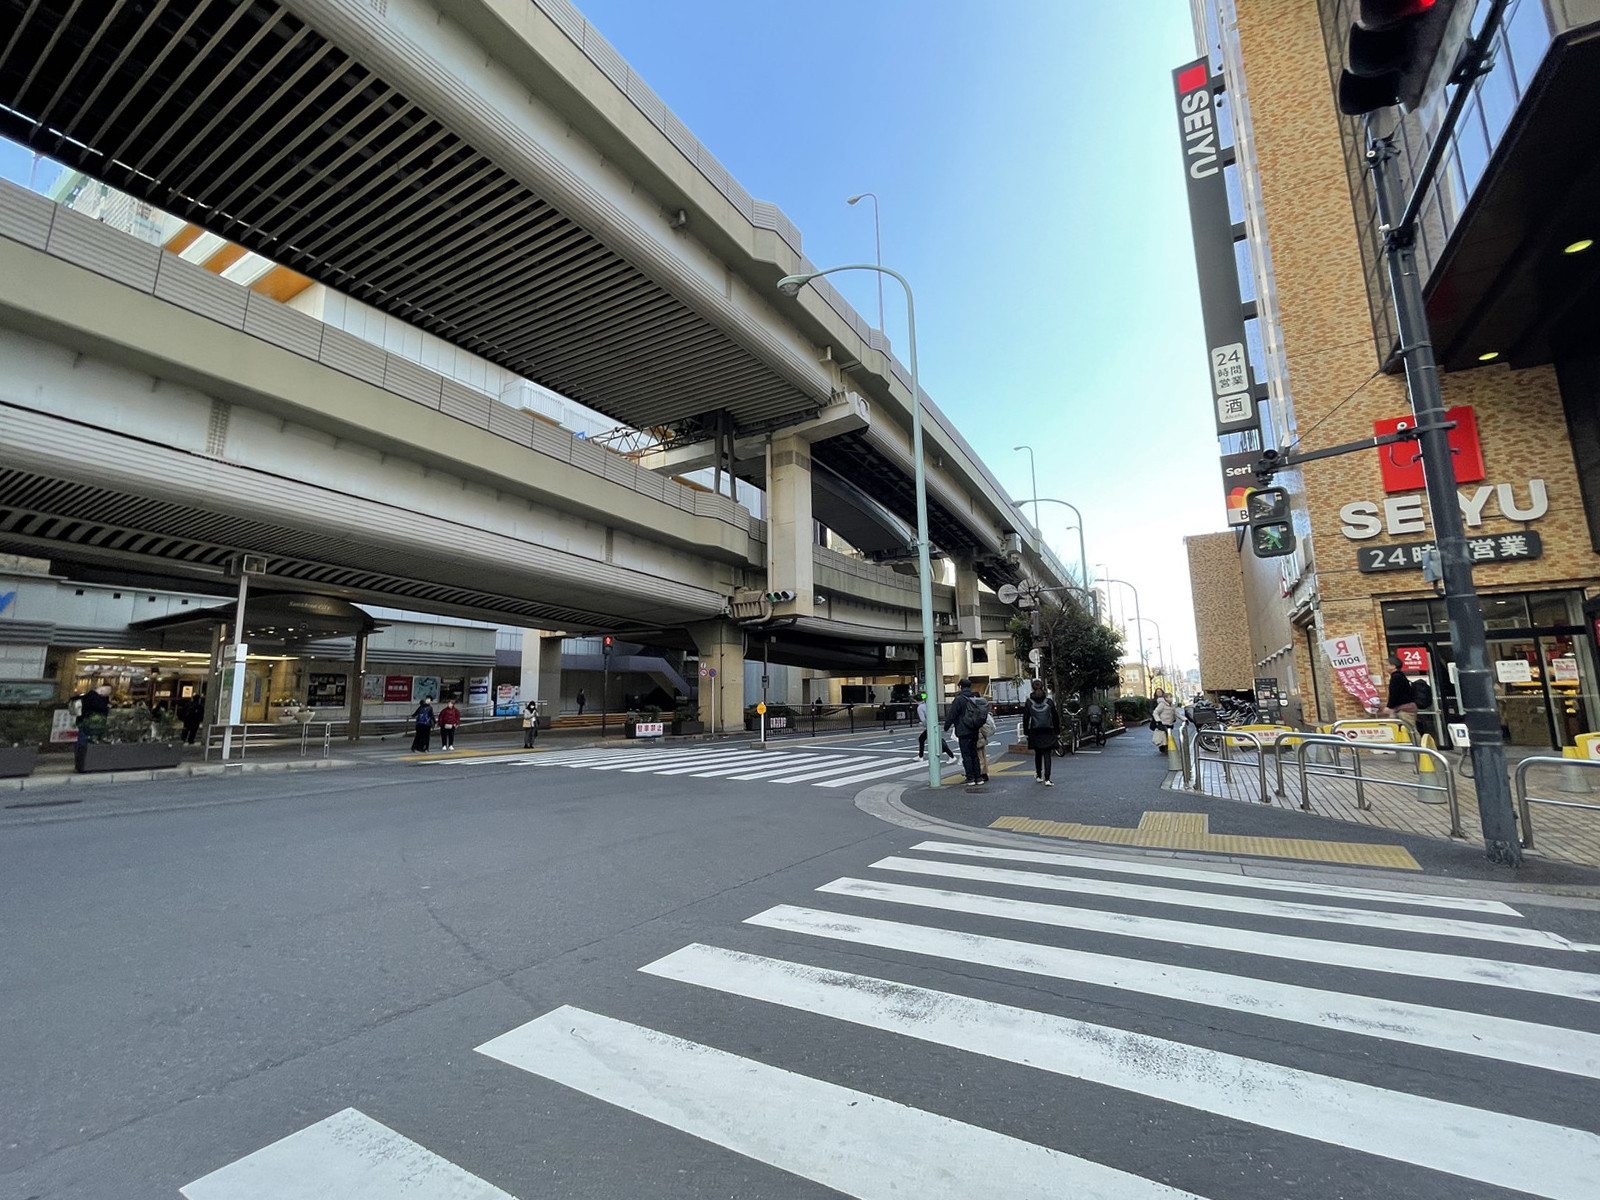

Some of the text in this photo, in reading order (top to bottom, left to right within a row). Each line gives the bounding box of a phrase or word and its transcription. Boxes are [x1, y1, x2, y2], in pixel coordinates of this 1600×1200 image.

[1181, 89, 1219, 179] SEIYU
[1216, 349, 1241, 367] 24
[1217, 364, 1242, 378] 時間
[1219, 375, 1244, 389] 営業
[1225, 397, 1243, 414] 酒
[1225, 464, 1252, 477] Seri
[1339, 478, 1549, 540] SEYU
[1369, 534, 1529, 569] 24時営業
[1403, 650, 1422, 661] 24
